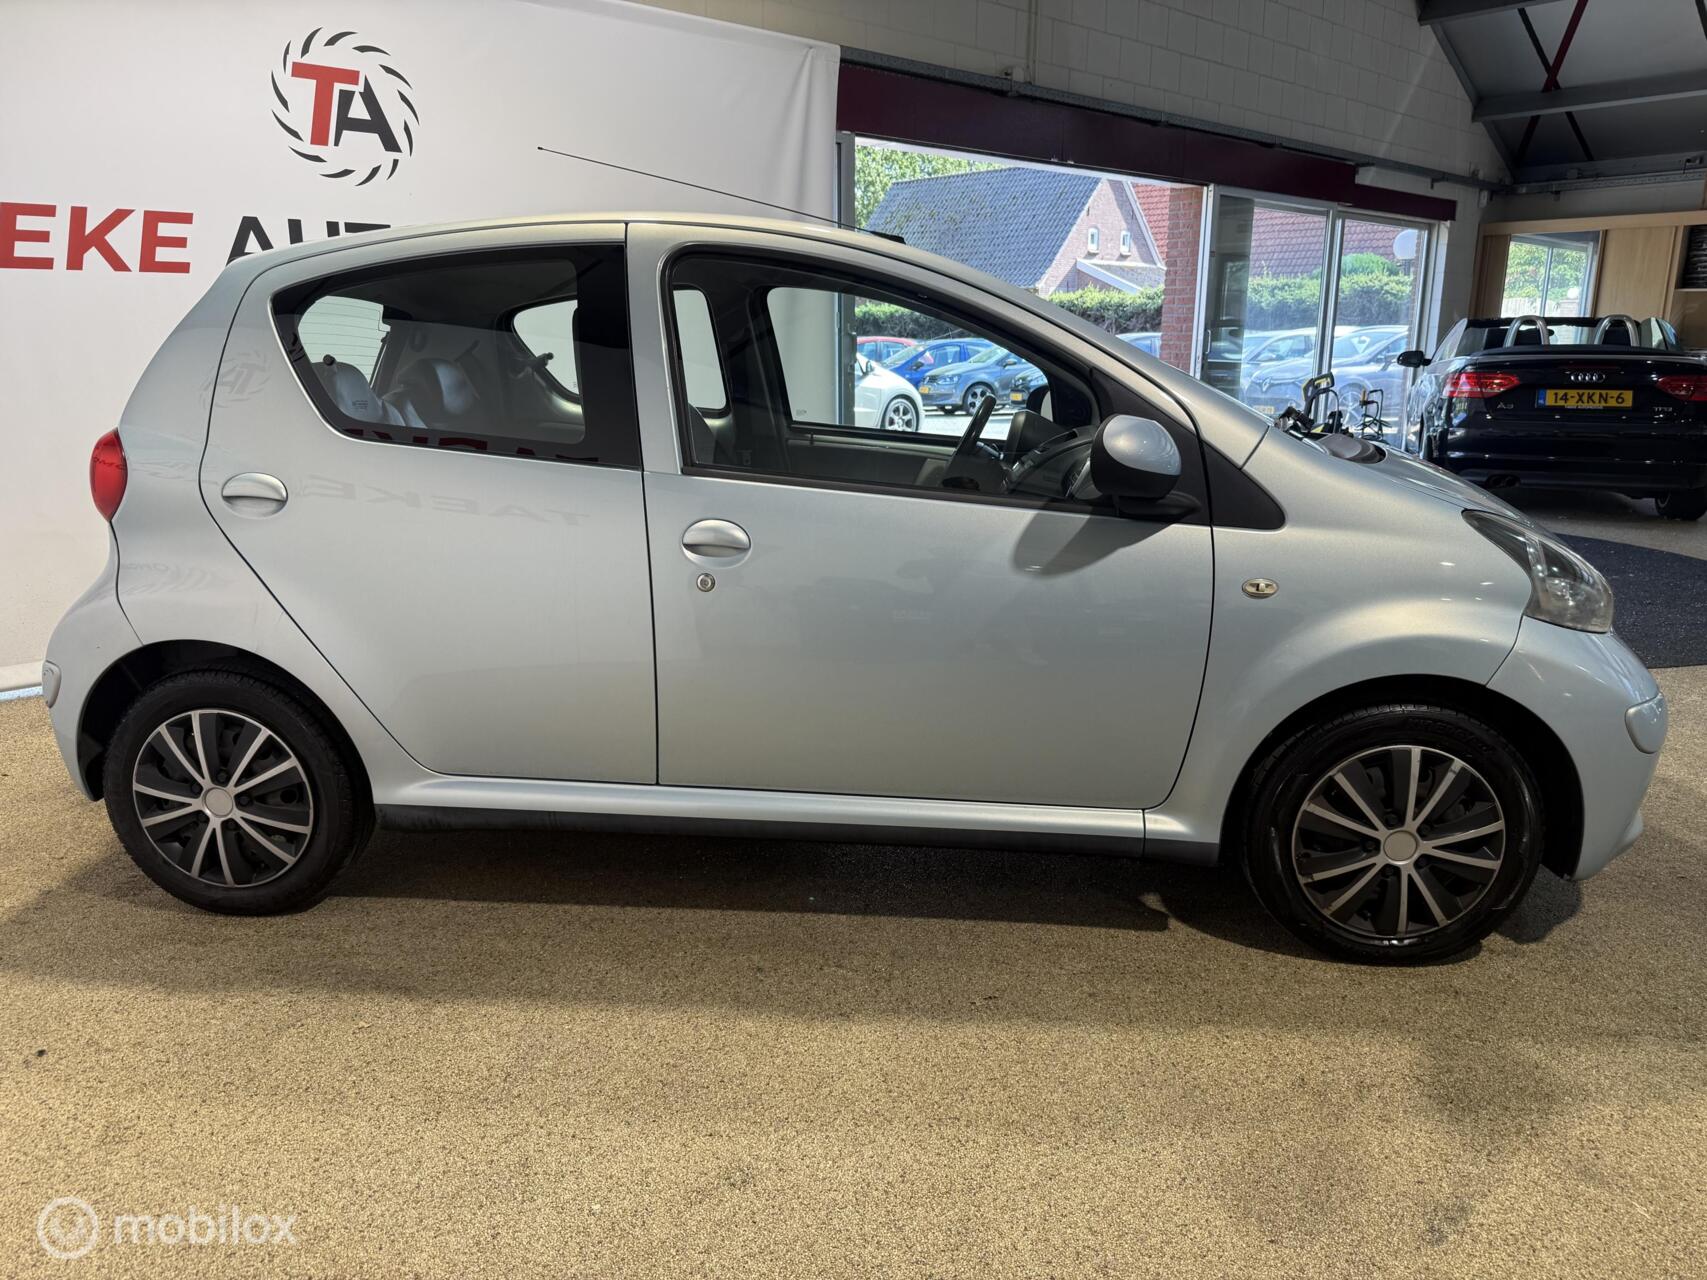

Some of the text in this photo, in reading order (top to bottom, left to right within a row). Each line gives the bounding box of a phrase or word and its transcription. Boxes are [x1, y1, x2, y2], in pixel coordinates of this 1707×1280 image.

[290, 61, 402, 153] TA
[0, 202, 194, 274] EKE
[1553, 391, 1625, 405] 14-XKN-6
